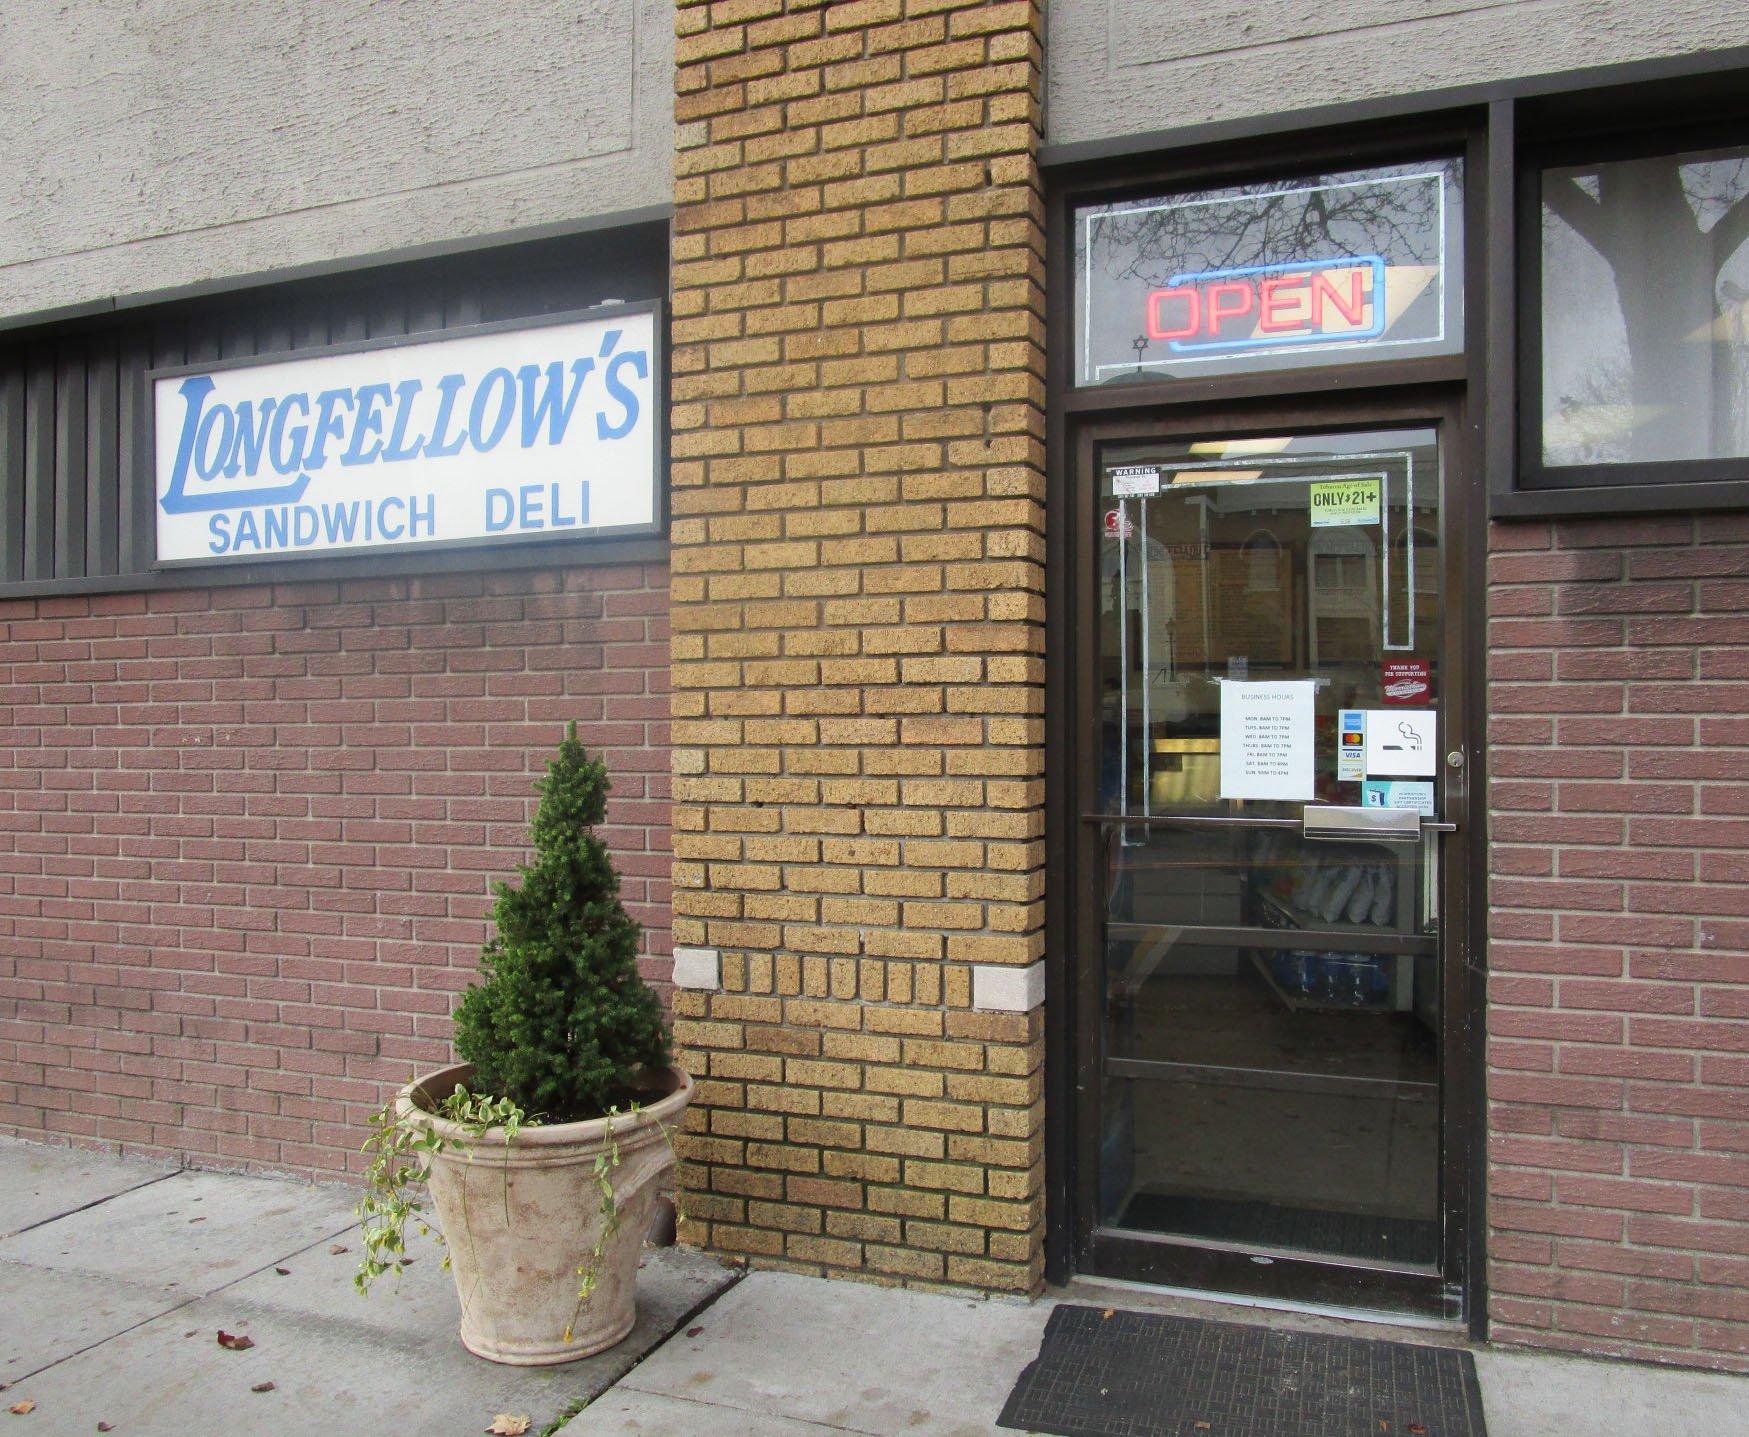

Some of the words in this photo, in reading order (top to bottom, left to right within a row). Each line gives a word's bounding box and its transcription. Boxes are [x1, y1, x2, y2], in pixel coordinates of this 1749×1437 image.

[1146, 271, 1364, 343] OPEN
[160, 329, 648, 515] LONGFELLOW'S
[1115, 467, 1157, 476] WARNING
[1313, 491, 1345, 507] ONLY
[1352, 490, 1377, 505] 21+
[208, 493, 436, 554] SANDWICH
[484, 480, 591, 533] DELI
